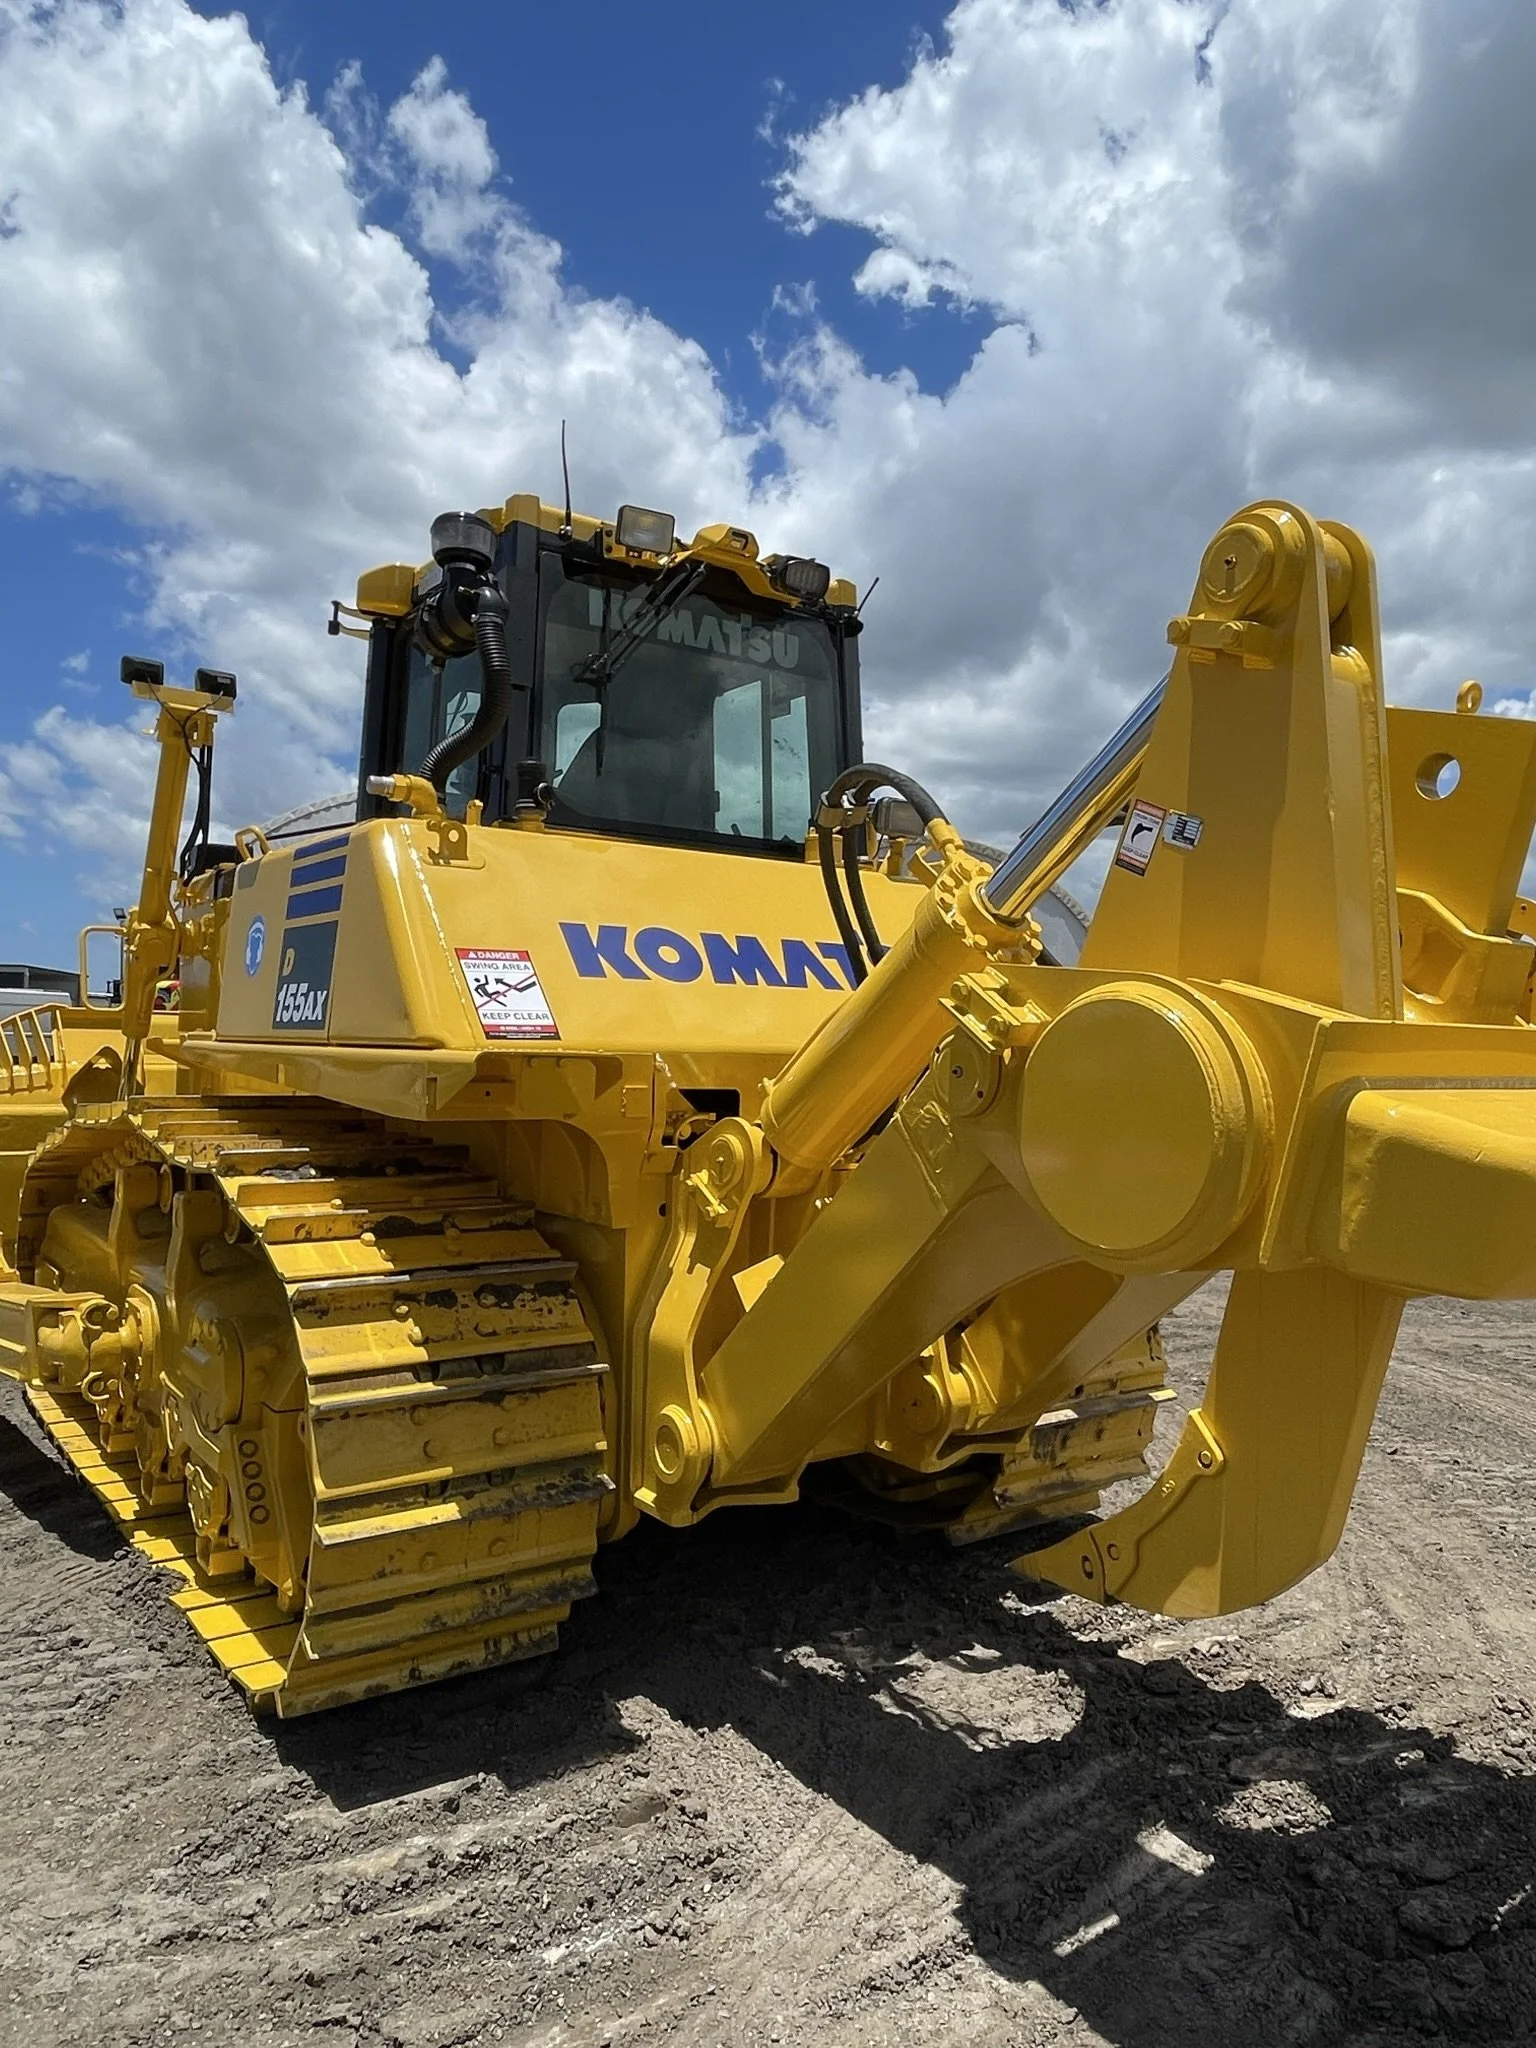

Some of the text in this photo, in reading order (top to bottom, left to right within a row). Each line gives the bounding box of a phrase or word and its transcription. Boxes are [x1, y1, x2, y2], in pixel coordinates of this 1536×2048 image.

[282, 948, 295, 976] D
[477, 951, 520, 960] DANGER
[559, 922, 891, 991] KOMAT
[463, 961, 531, 971] SWING AREA
[275, 982, 328, 1023] 155AX
[482, 1012, 550, 1021] KEEP CLEAR
